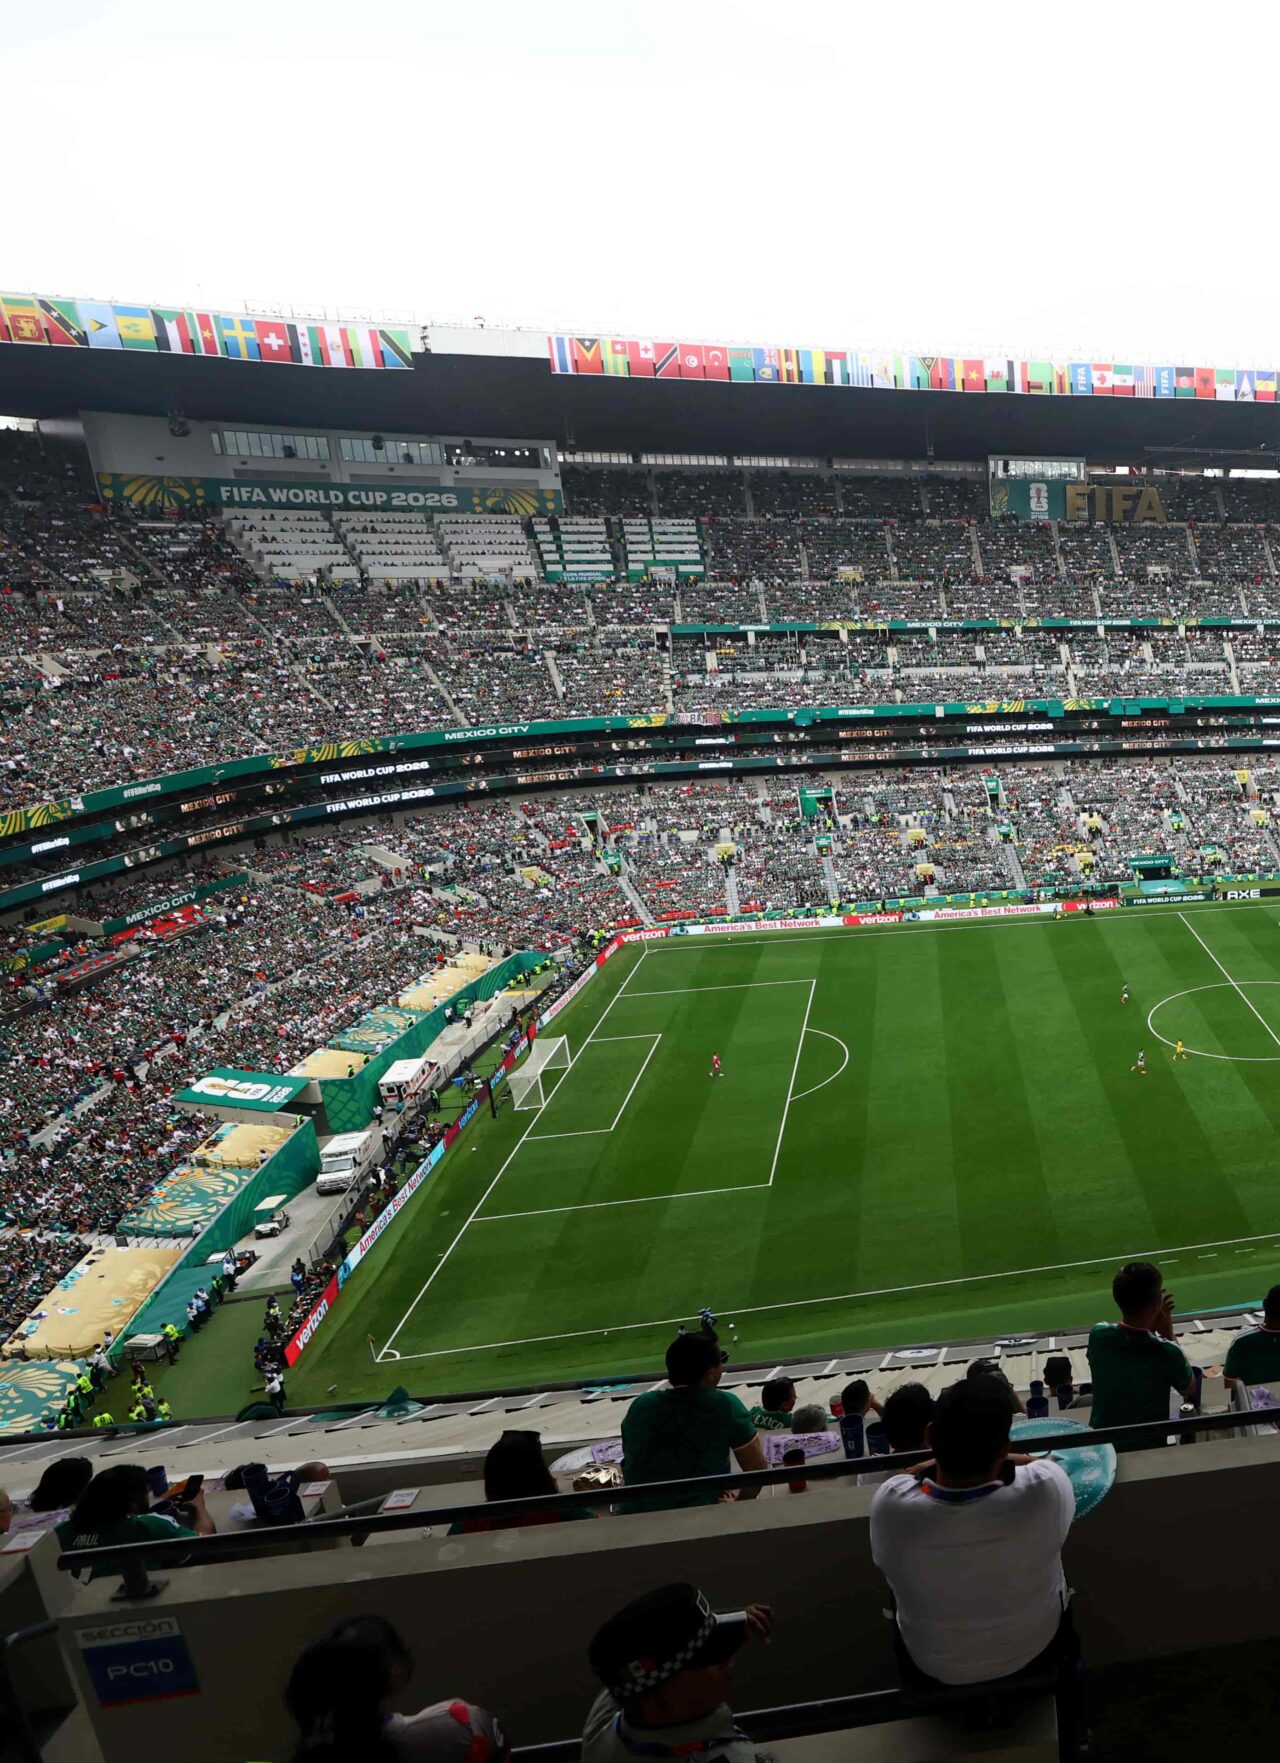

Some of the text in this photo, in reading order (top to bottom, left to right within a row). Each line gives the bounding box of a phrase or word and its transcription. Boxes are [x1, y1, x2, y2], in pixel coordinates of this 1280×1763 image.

[220, 486, 458, 506] FIFA WORLD CUP 2026
[1065, 485, 1166, 520] FIFA
[444, 726, 529, 740] MEXICO CITY
[839, 730, 872, 738] MEXICO
[983, 724, 1010, 732] WORLD
[1011, 723, 1027, 731] CUP
[1028, 722, 1053, 730] 2026
[513, 745, 577, 759] MEXICO CITY
[876, 752, 896, 760] CITY
[1029, 745, 1054, 753] 2026
[320, 761, 429, 784] FIFA WORLD CUP 2026
[517, 773, 555, 784] MEXICO
[181, 792, 237, 813] MEXICO CITY
[326, 788, 434, 813] FIFA WORLD CUP 2026
[187, 824, 244, 846] MEXICO CITY
[1227, 889, 1260, 899] AXE
[126, 891, 196, 924] MEXICO CITY
[934, 905, 1041, 919] America's Best Network
[704, 919, 820, 933] America's Best Network
[859, 914, 899, 924] verizon
[622, 930, 665, 942] verizon
[458, 1099, 478, 1129] verizon
[359, 1158, 432, 1255] America's Best Network
[295, 1298, 328, 1350] verizon
[754, 1415, 784, 1430] EXICO
[106, 1658, 175, 1680] PC10
